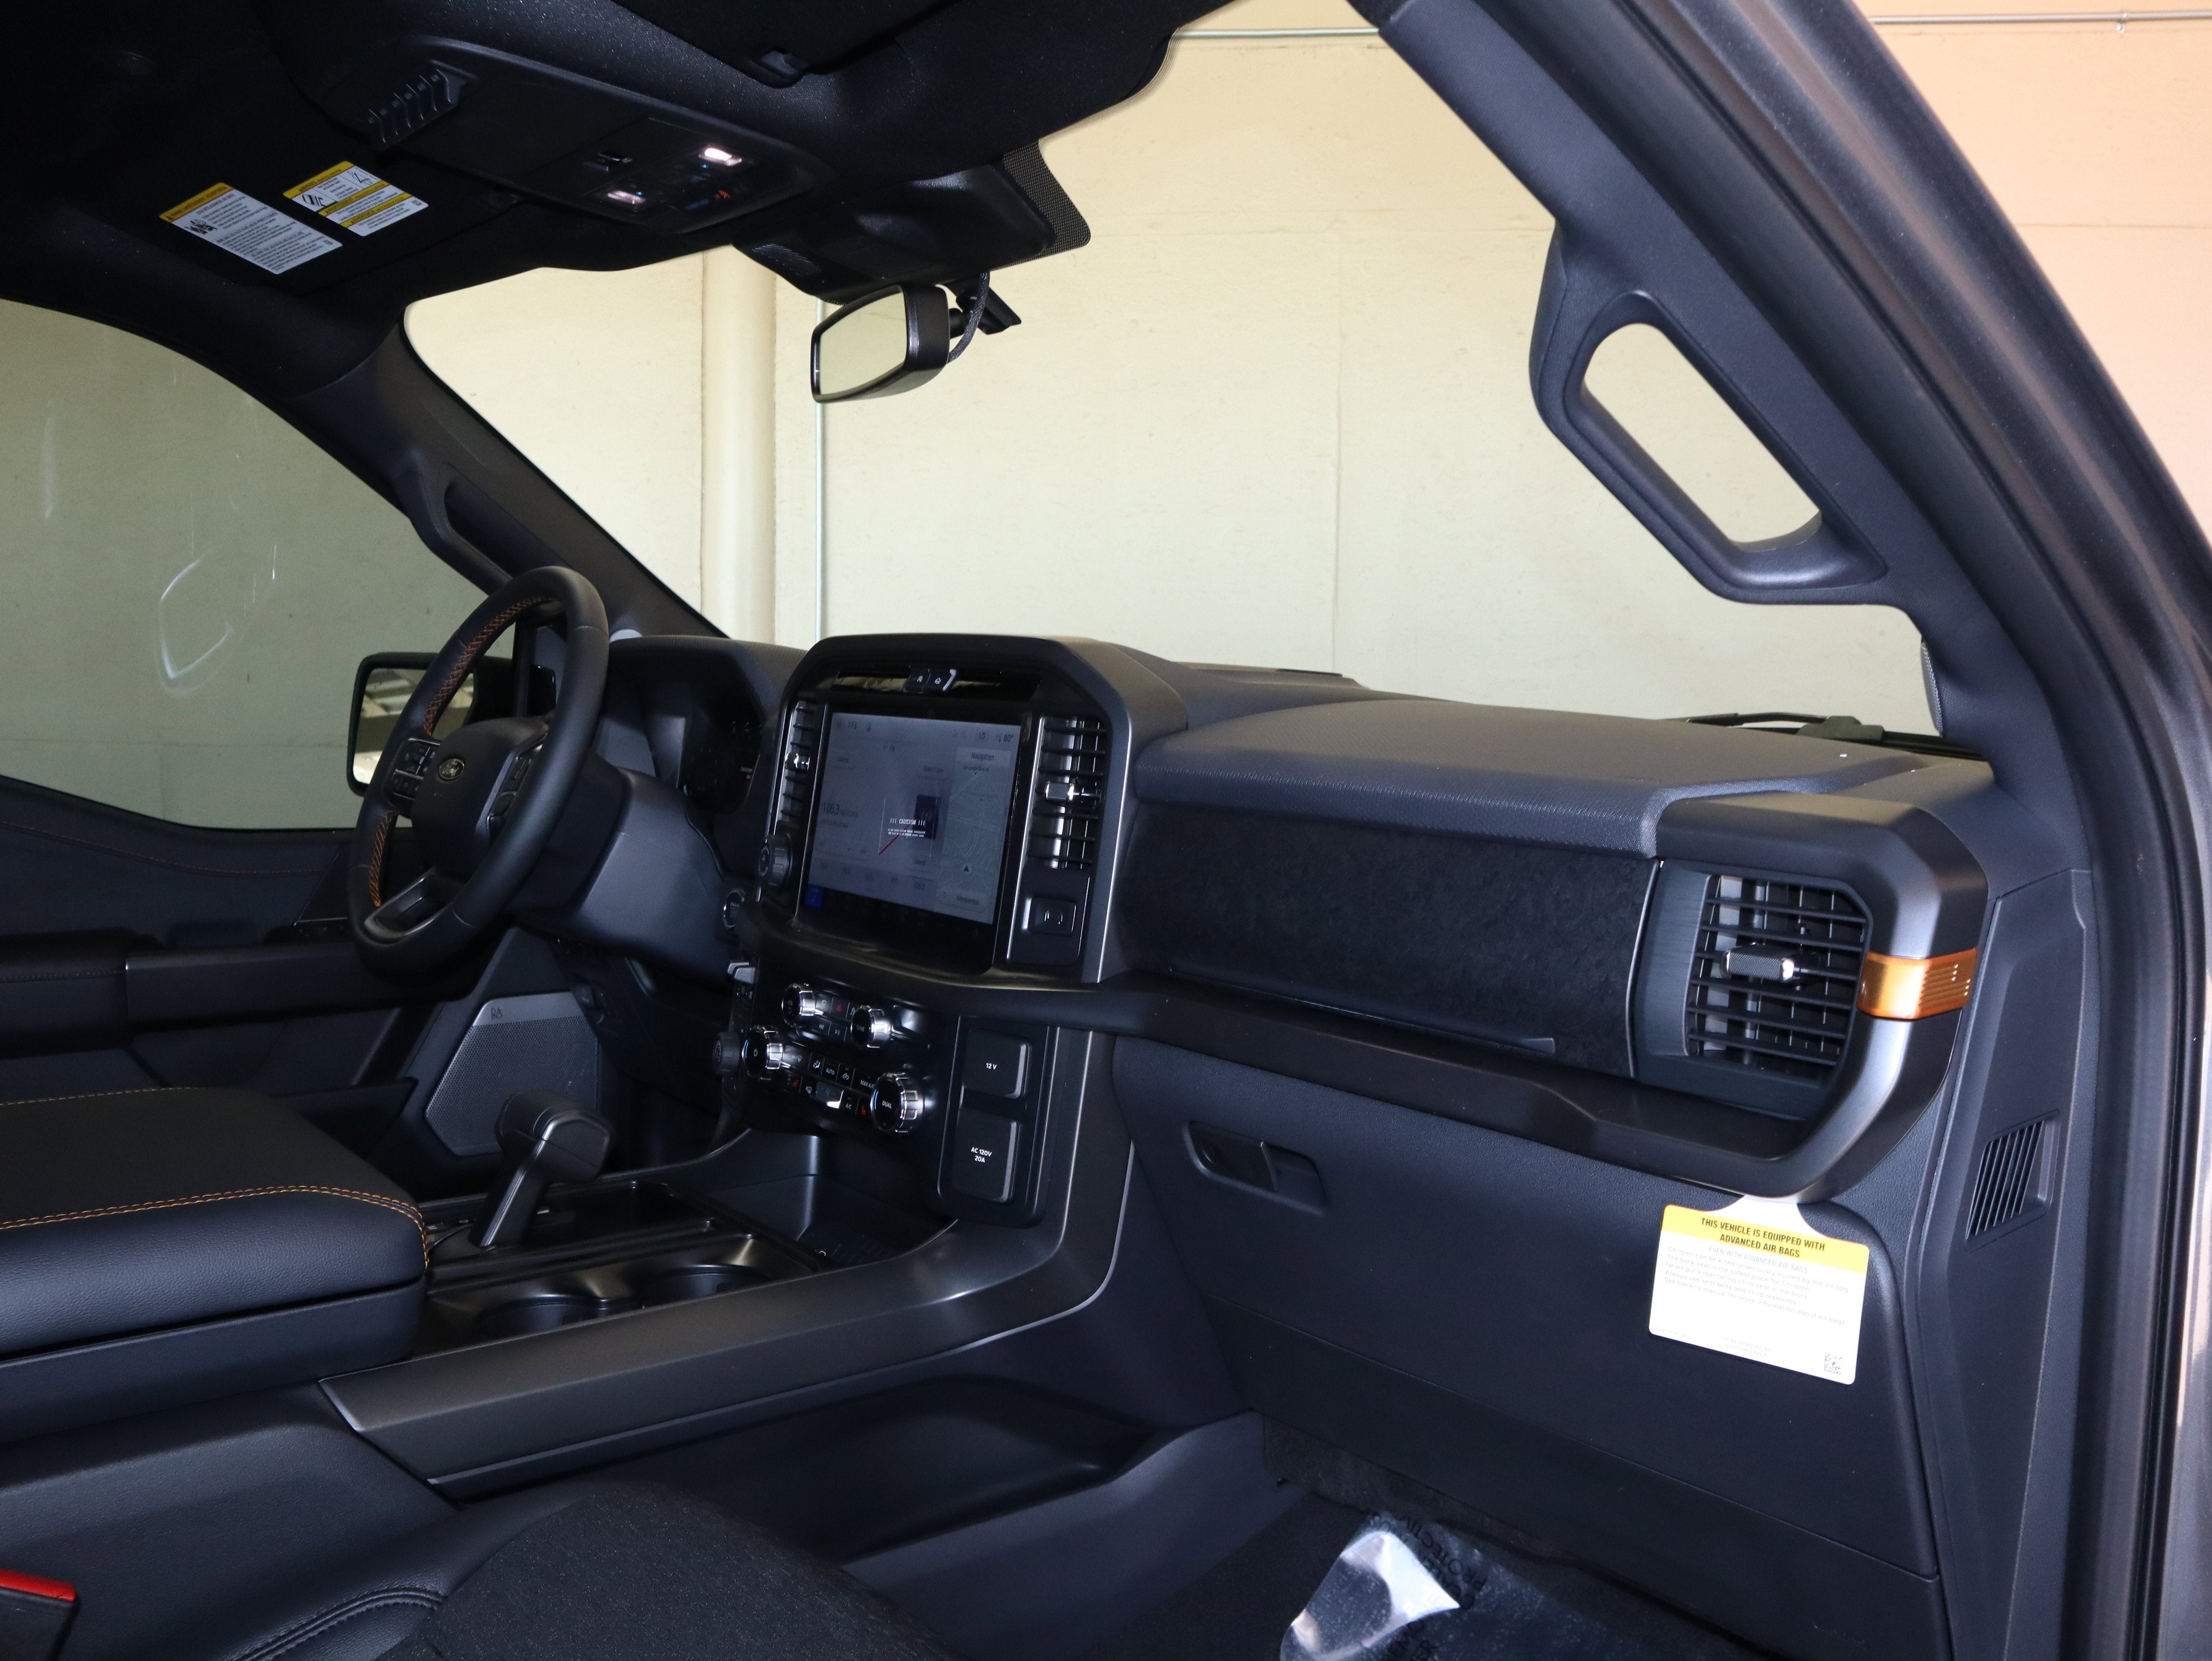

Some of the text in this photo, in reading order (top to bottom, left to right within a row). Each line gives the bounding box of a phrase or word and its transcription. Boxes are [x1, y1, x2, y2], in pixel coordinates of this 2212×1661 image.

[971, 752, 995, 761] Navigation
[882, 1100, 892, 1109] DUAL
[1701, 1218, 1825, 1251] THIS VEHICLE IS EQUIPPED WITH
[1720, 1235, 1801, 1258] ADVANCED AIR BAGS
[1668, 1247, 1694, 1257] Children
[1718, 1258, 1735, 1267] killed
[1745, 1265, 1775, 1276] seriously
[1777, 1271, 1800, 1281] injured
[1709, 1246, 1724, 1254] EVEN
[1744, 1254, 1776, 1267] ADVANCED
[1791, 1264, 1808, 1274] BAGS
[1665, 1270, 1687, 1279] Always
[1748, 1289, 1764, 1298] child
[1766, 1294, 1797, 1305] restraints
[1717, 1274, 1736, 1284] facing
[1738, 1279, 1754, 1287] child
[1792, 1291, 1808, 1299] front
[1751, 1274, 1769, 1283] place
[1782, 1281, 1810, 1292] Children
[1703, 1287, 1726, 1296] manual
[1757, 1300, 1795, 1313] information
[1797, 1310, 1816, 1318] about
[1829, 1317, 1845, 1325] bags
[1397, 1515, 1487, 1592] PROTECTIV
